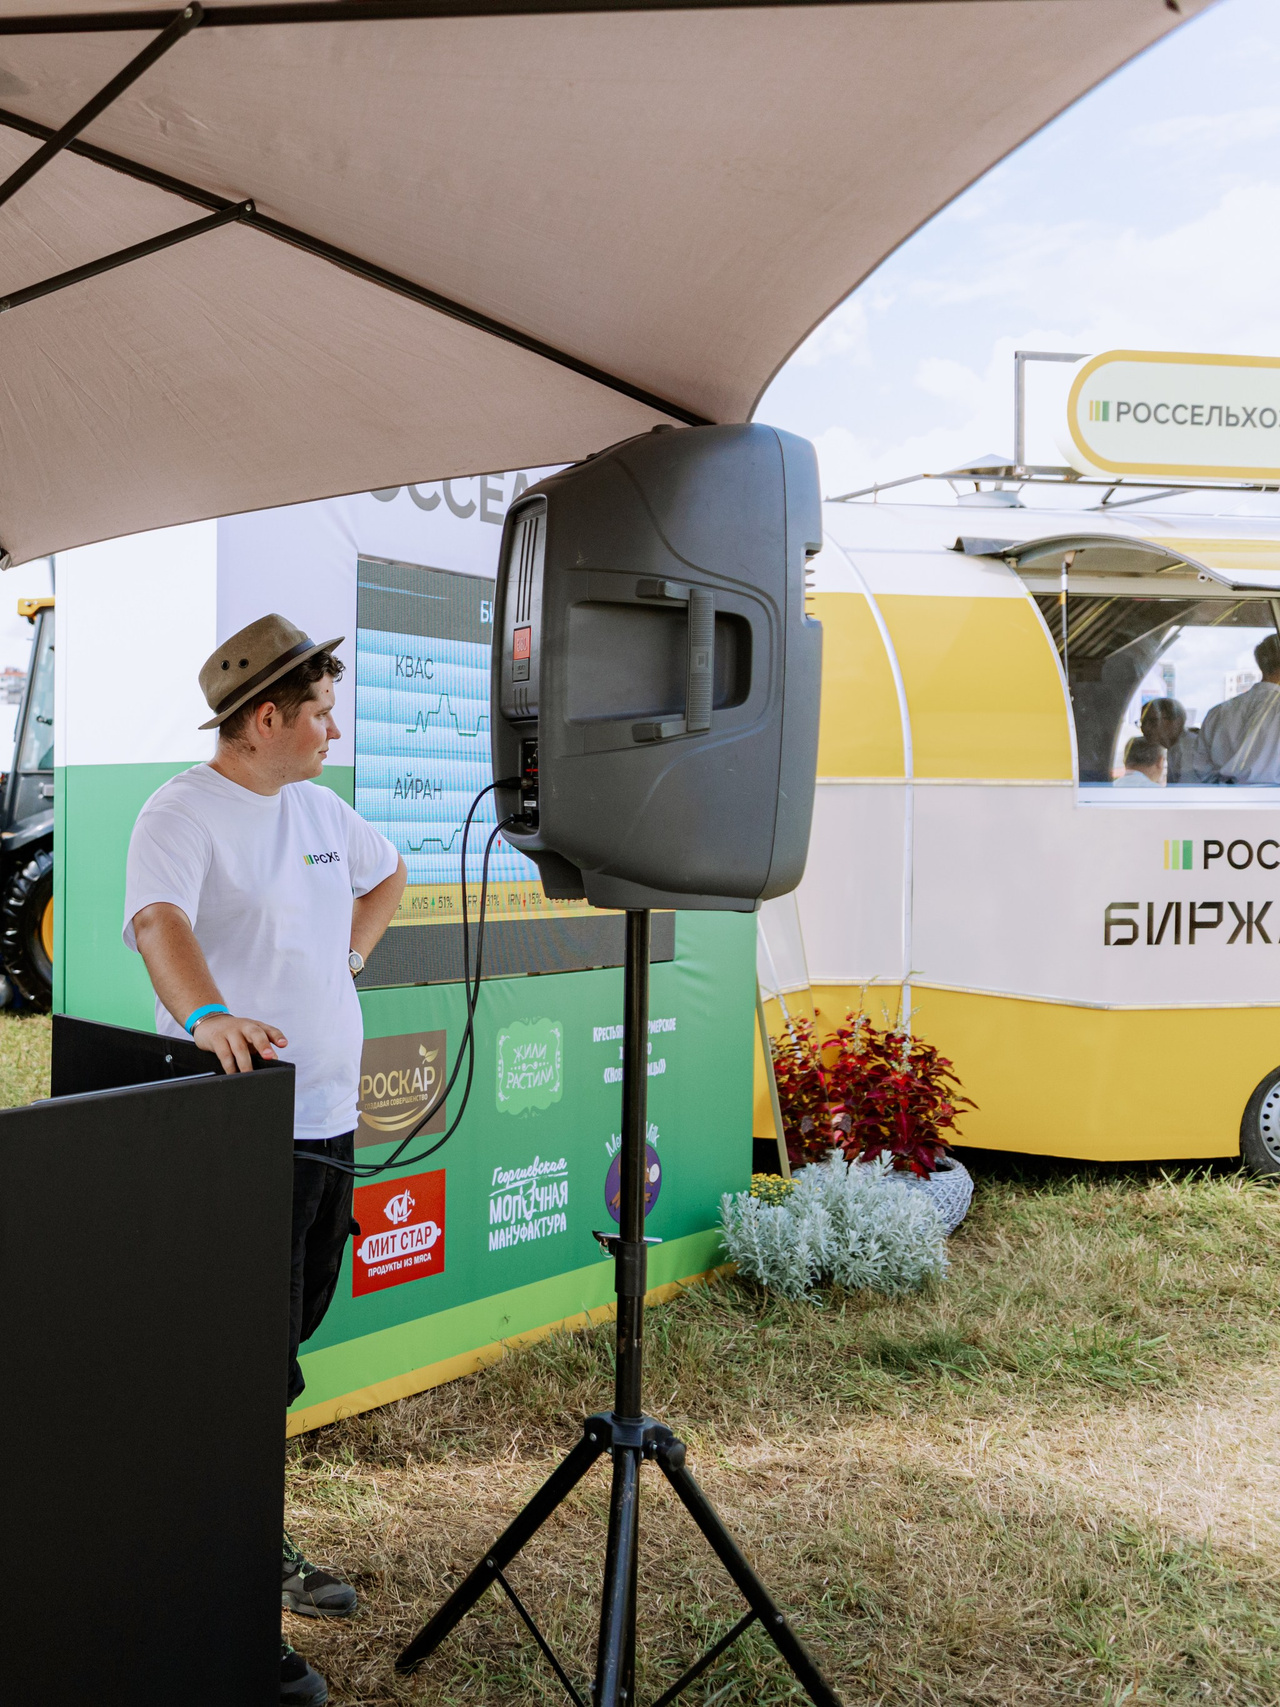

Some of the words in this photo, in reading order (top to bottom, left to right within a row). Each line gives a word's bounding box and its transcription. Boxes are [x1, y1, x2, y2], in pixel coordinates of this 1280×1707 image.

[1116, 401, 1280, 429] РОССЕЛЬХО
[395, 654, 434, 680] КВАС
[393, 772, 443, 801] АЙРАН
[1203, 839, 1280, 870] РОС
[1104, 901, 1280, 946] БИРЖ
[513, 1043, 547, 1064] ЖИЛИ
[360, 1066, 436, 1101] РОСКАР
[506, 1065, 555, 1089] РАСТИЛИ
[390, 1093, 429, 1106] СОВЕРШЕНСТВО
[491, 1155, 568, 1189] Георгиевская
[367, 1233, 398, 1259] МИТ
[400, 1225, 433, 1251] СТАР
[488, 1212, 568, 1252] МАНУФАКТУРА
[367, 1261, 403, 1278] ПРОДУКТЫ
[403, 1257, 413, 1268] ИЗ
[413, 1252, 433, 1265] МЯСА
